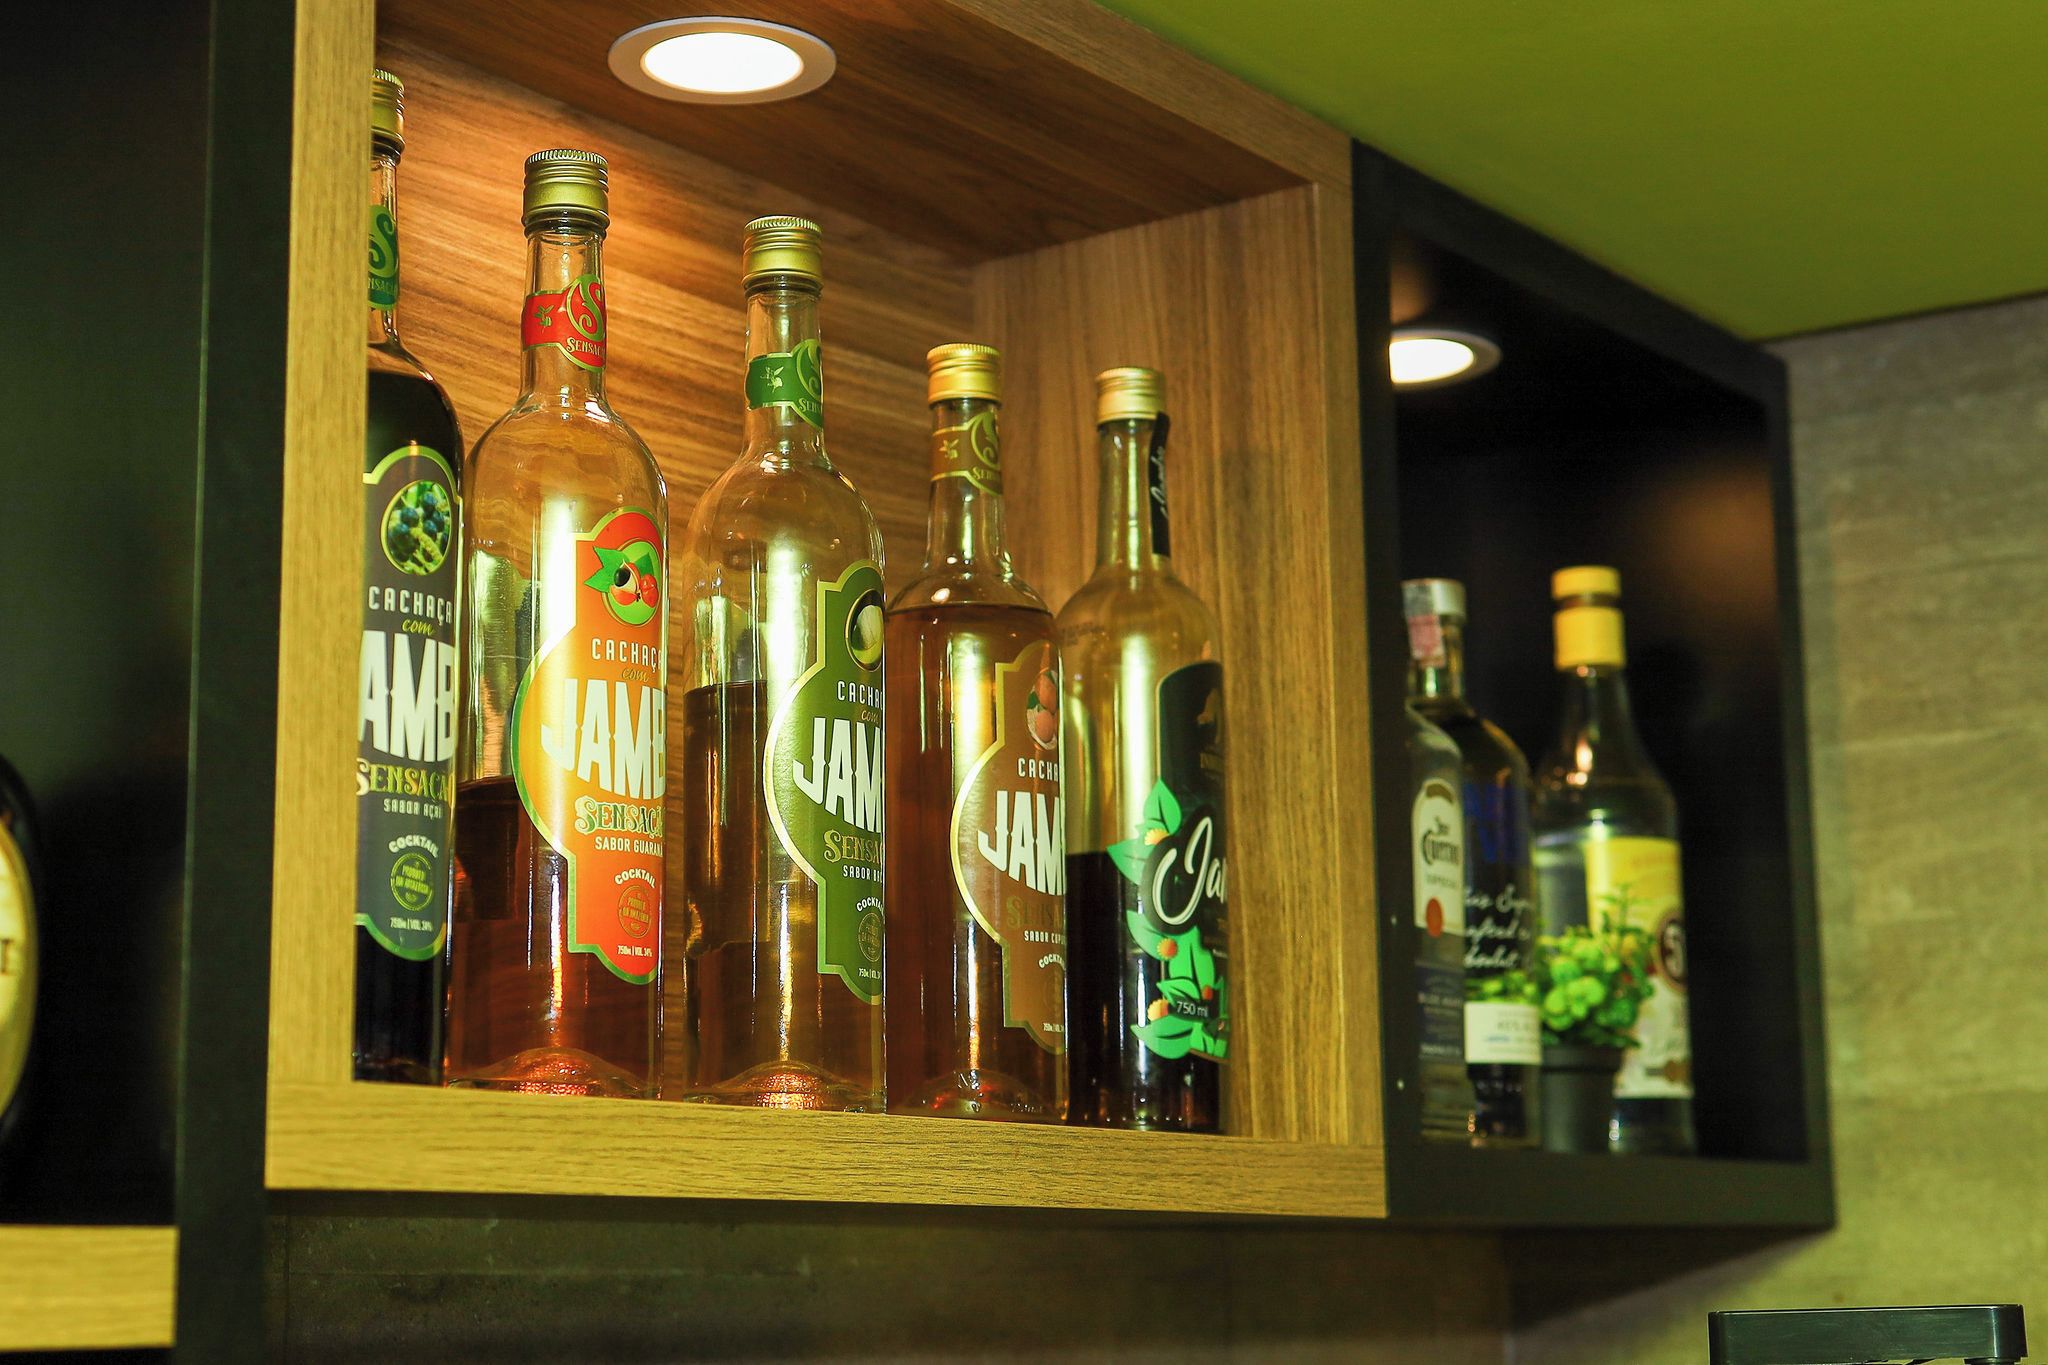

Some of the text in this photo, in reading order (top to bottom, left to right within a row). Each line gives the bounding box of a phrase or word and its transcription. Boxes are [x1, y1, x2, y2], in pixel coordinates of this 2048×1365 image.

[368, 586, 452, 626] CACHAÇA
[402, 619, 433, 636] com
[384, 798, 420, 815] SABOR
[389, 834, 439, 859] COCKTAIL
[595, 836, 630, 852] SABOR
[614, 868, 655, 888] COCKTAIL
[843, 865, 871, 880] SABOR
[1024, 930, 1049, 943] SABOR
[1177, 1001, 1209, 1018] 750 ml
